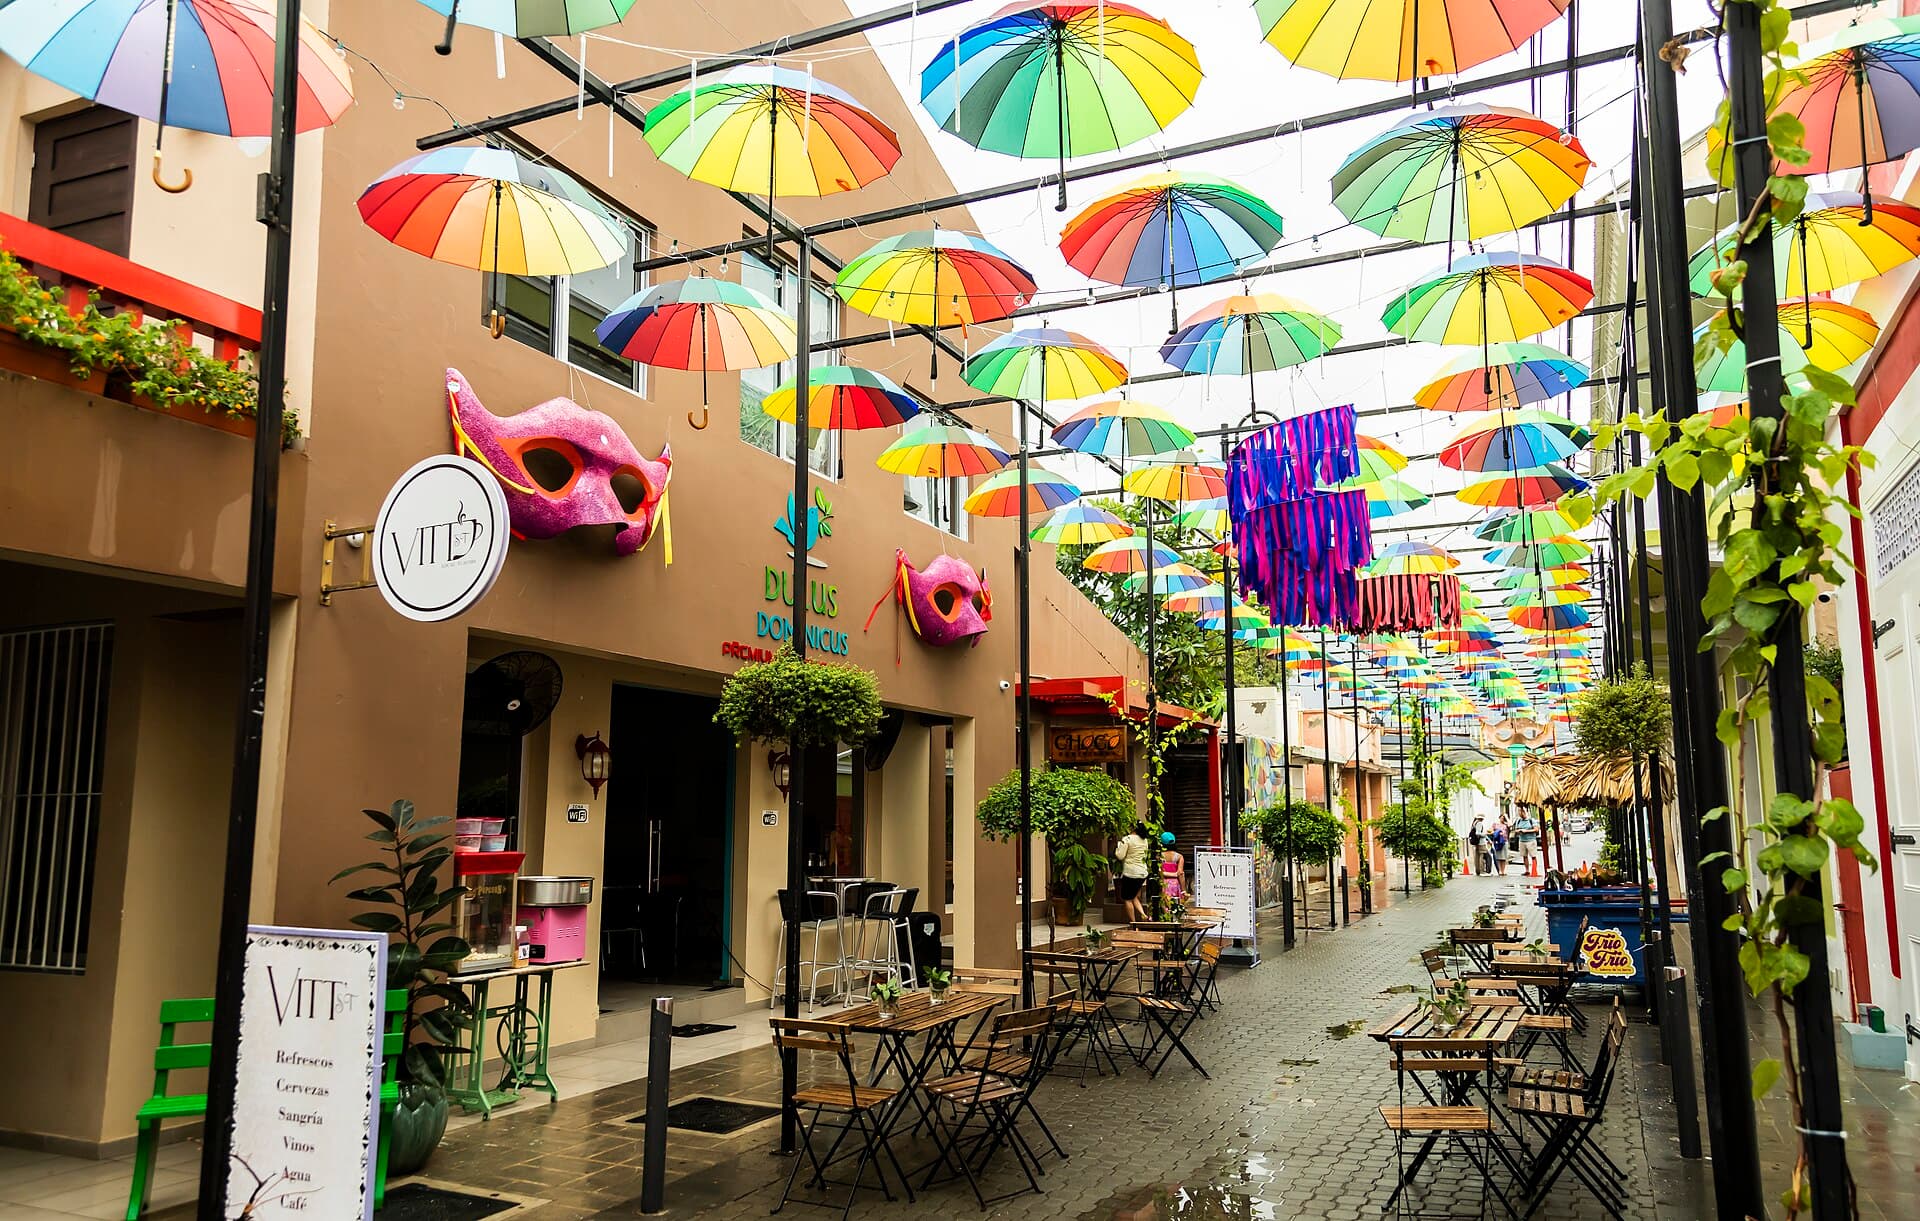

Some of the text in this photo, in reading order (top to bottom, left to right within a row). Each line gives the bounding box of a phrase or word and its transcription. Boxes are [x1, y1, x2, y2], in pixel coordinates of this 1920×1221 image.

[765, 565, 838, 618] DUUS
[757, 611, 848, 656] DOMNICUS
[1055, 734, 1120, 751] CHOCO
[276, 1050, 333, 1068] Refrescos
[276, 1078, 329, 1096] Cervezas
[279, 1106, 323, 1126] Sangría
[283, 1135, 315, 1152] Vinos
[282, 1165, 311, 1183] Agua
[280, 1194, 307, 1210] Café
